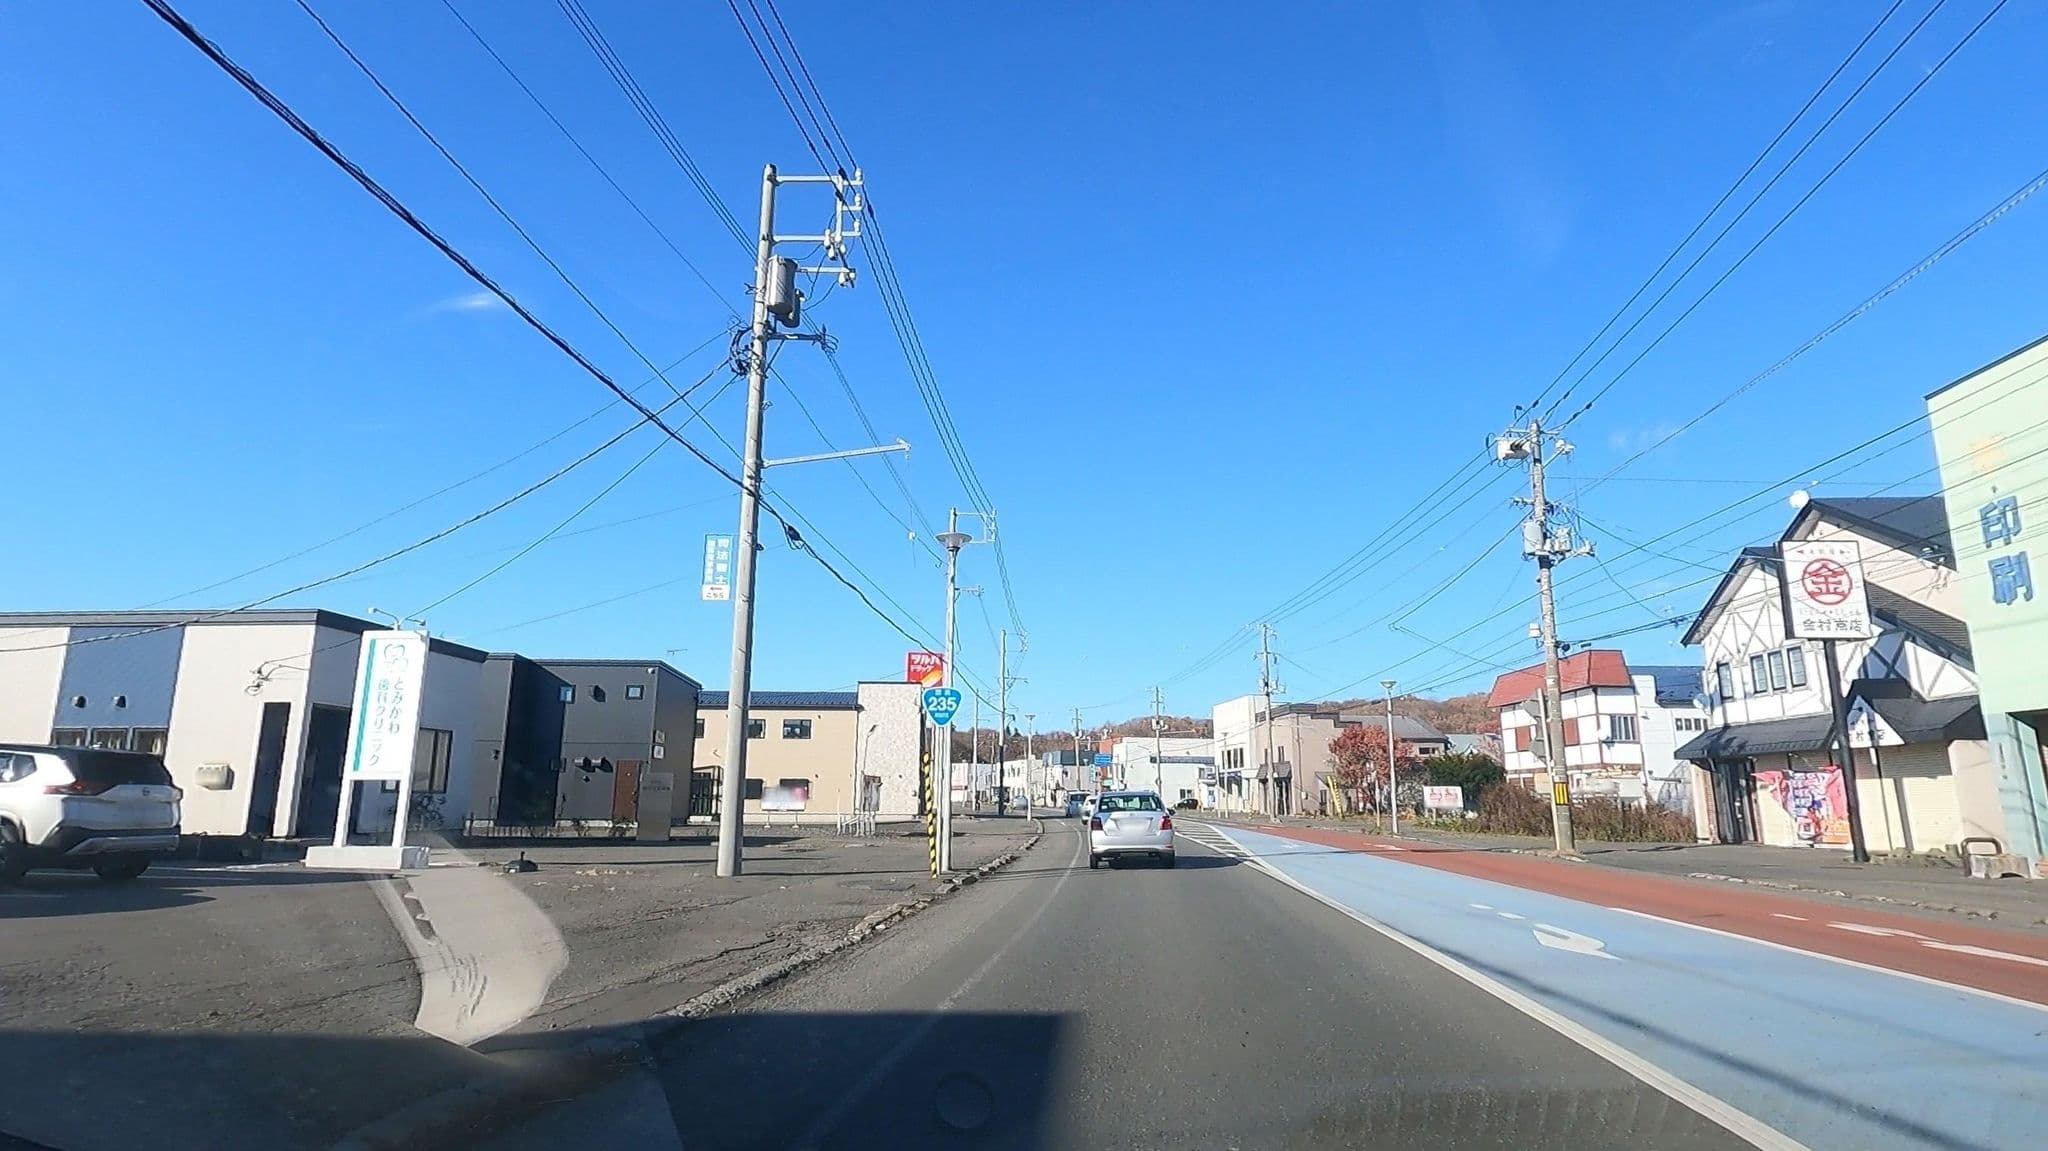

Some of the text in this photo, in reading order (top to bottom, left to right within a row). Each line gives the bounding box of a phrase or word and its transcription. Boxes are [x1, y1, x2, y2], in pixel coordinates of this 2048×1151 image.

[1979, 496, 2033, 606] 印刷
[1803, 618, 1862, 631] 金村商店
[389, 678, 404, 734] とみかわ
[928, 697, 957, 711] 235
